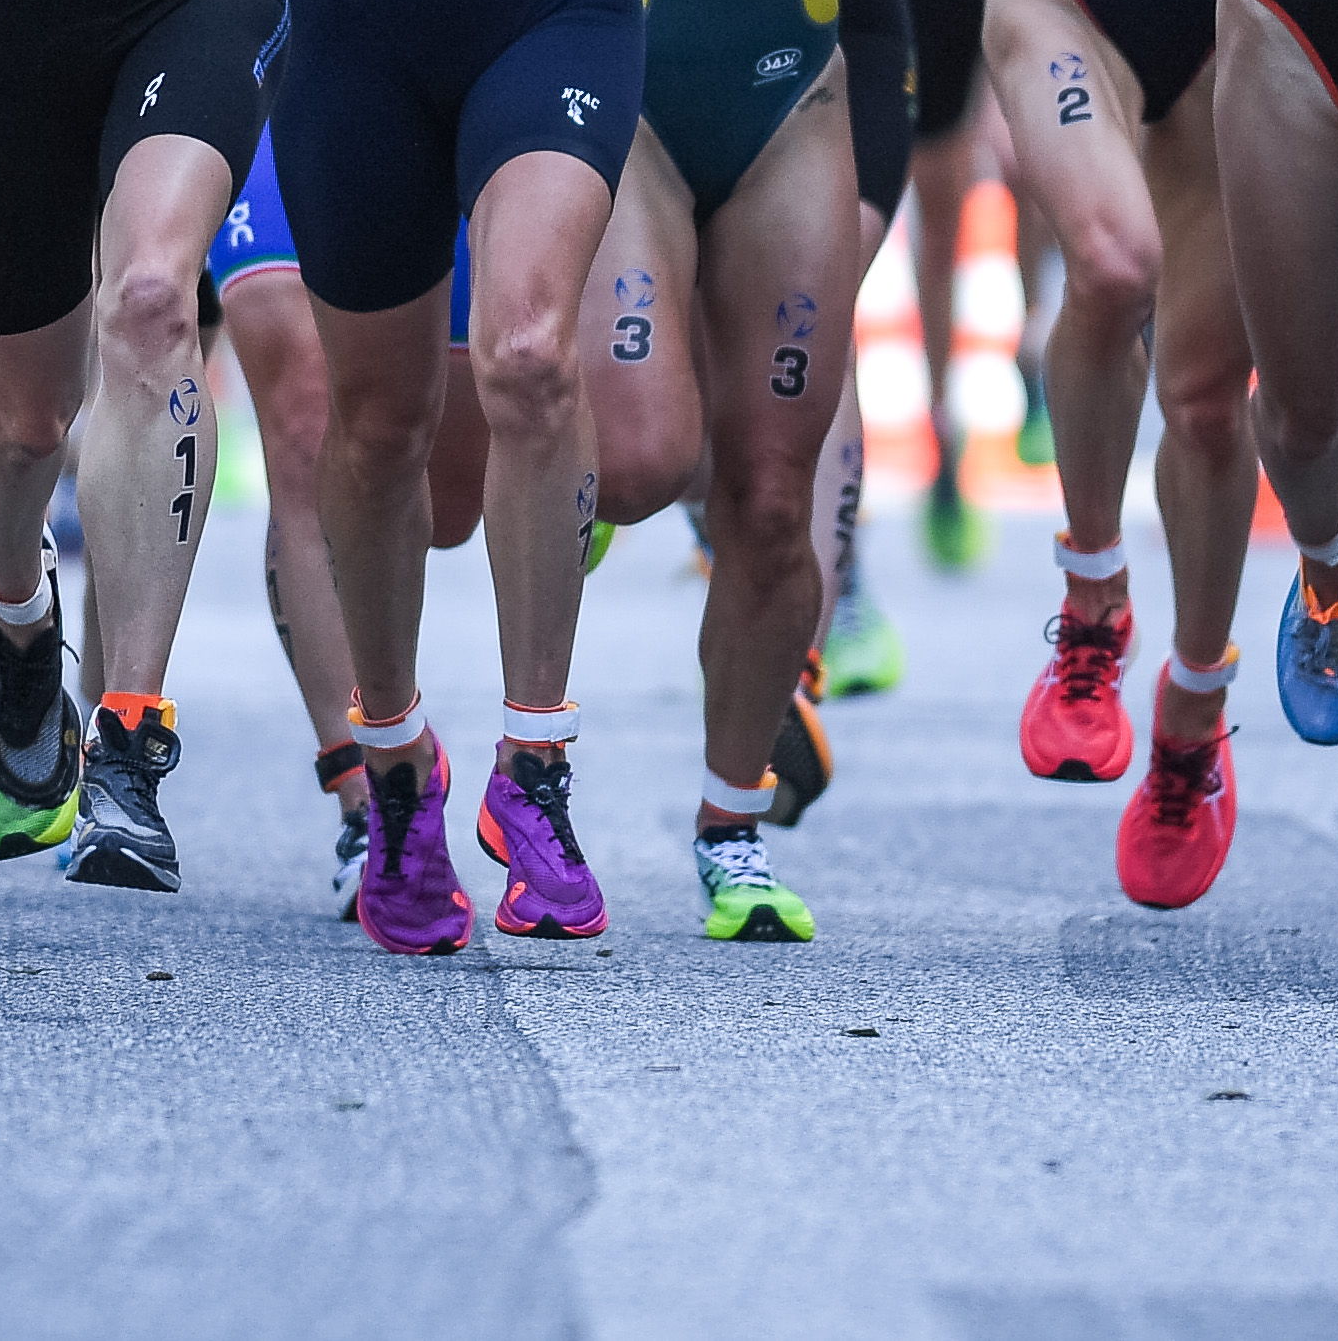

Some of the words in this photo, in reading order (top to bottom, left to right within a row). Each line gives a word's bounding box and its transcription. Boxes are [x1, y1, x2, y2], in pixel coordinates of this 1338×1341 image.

[561, 87, 601, 110] NYAC
[1057, 86, 1093, 126] 2
[611, 314, 653, 363] 3
[770, 345, 809, 399] 3
